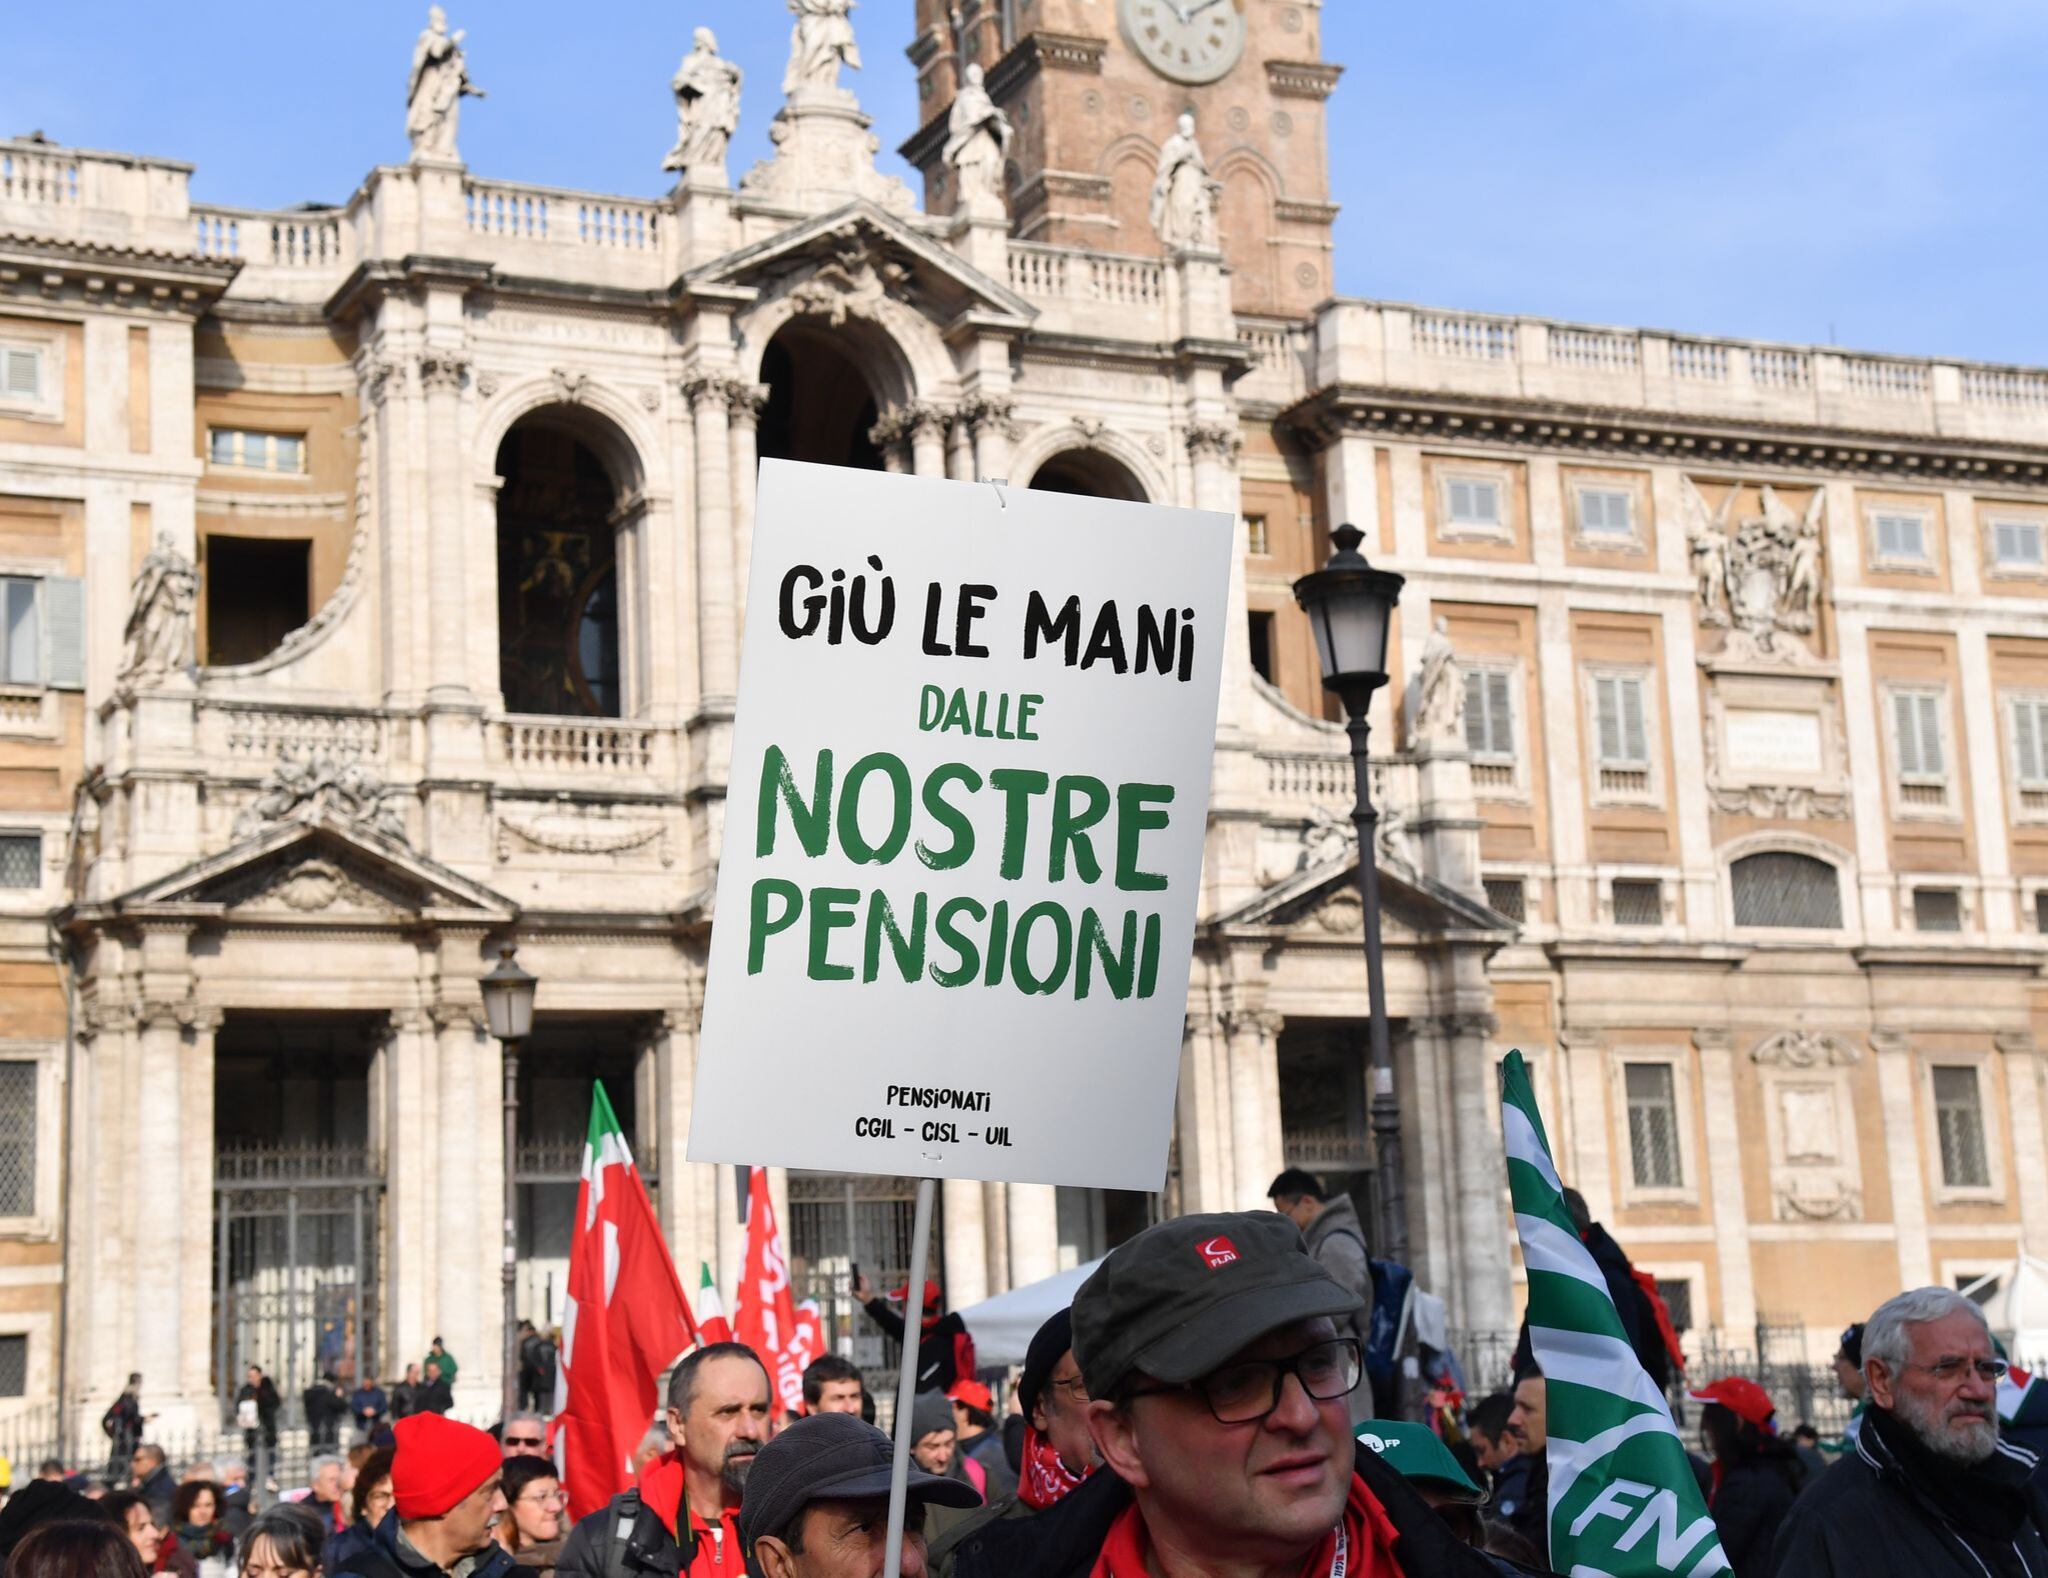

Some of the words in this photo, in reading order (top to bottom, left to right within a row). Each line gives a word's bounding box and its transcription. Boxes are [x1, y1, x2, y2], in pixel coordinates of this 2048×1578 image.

[922, 582, 998, 658] LE
[919, 685, 1044, 741] DALLE
[756, 744, 1175, 892] NOSTRE
[748, 878, 1161, 1001] PENSIONI
[855, 1116, 896, 1139] CGIL
[921, 1121, 960, 1144] CISL
[985, 1126, 1013, 1147] UIL
[1210, 1253, 1237, 1268] FLAI
[1384, 1439, 1401, 1448] FP
